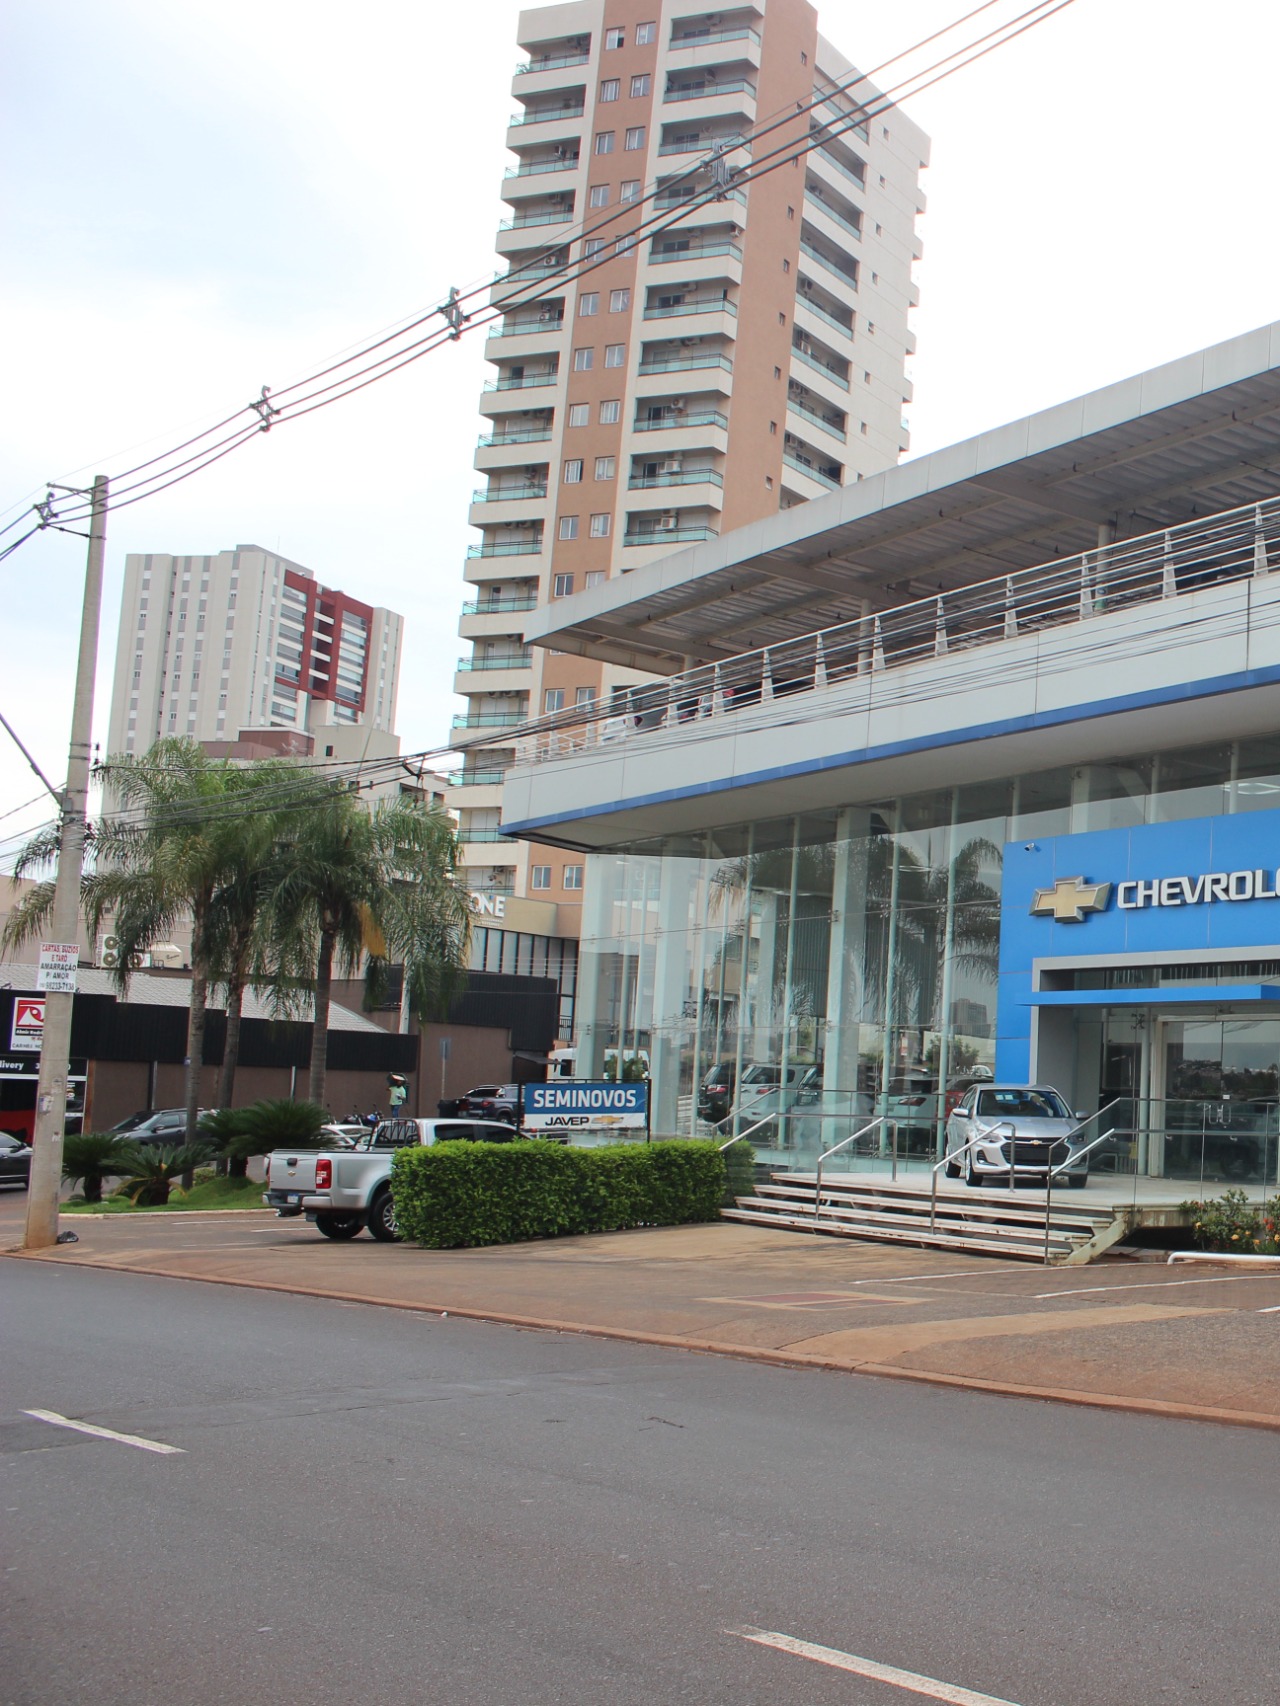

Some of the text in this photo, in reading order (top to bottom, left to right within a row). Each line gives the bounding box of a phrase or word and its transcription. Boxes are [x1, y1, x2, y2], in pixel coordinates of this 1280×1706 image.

[469, 892, 506, 918] ONE
[52, 972, 69, 980] AMOR
[0, 1060, 24, 1071] livery
[533, 1089, 636, 1108] SEMINOVOS
[545, 1116, 590, 1126] JAVEP
